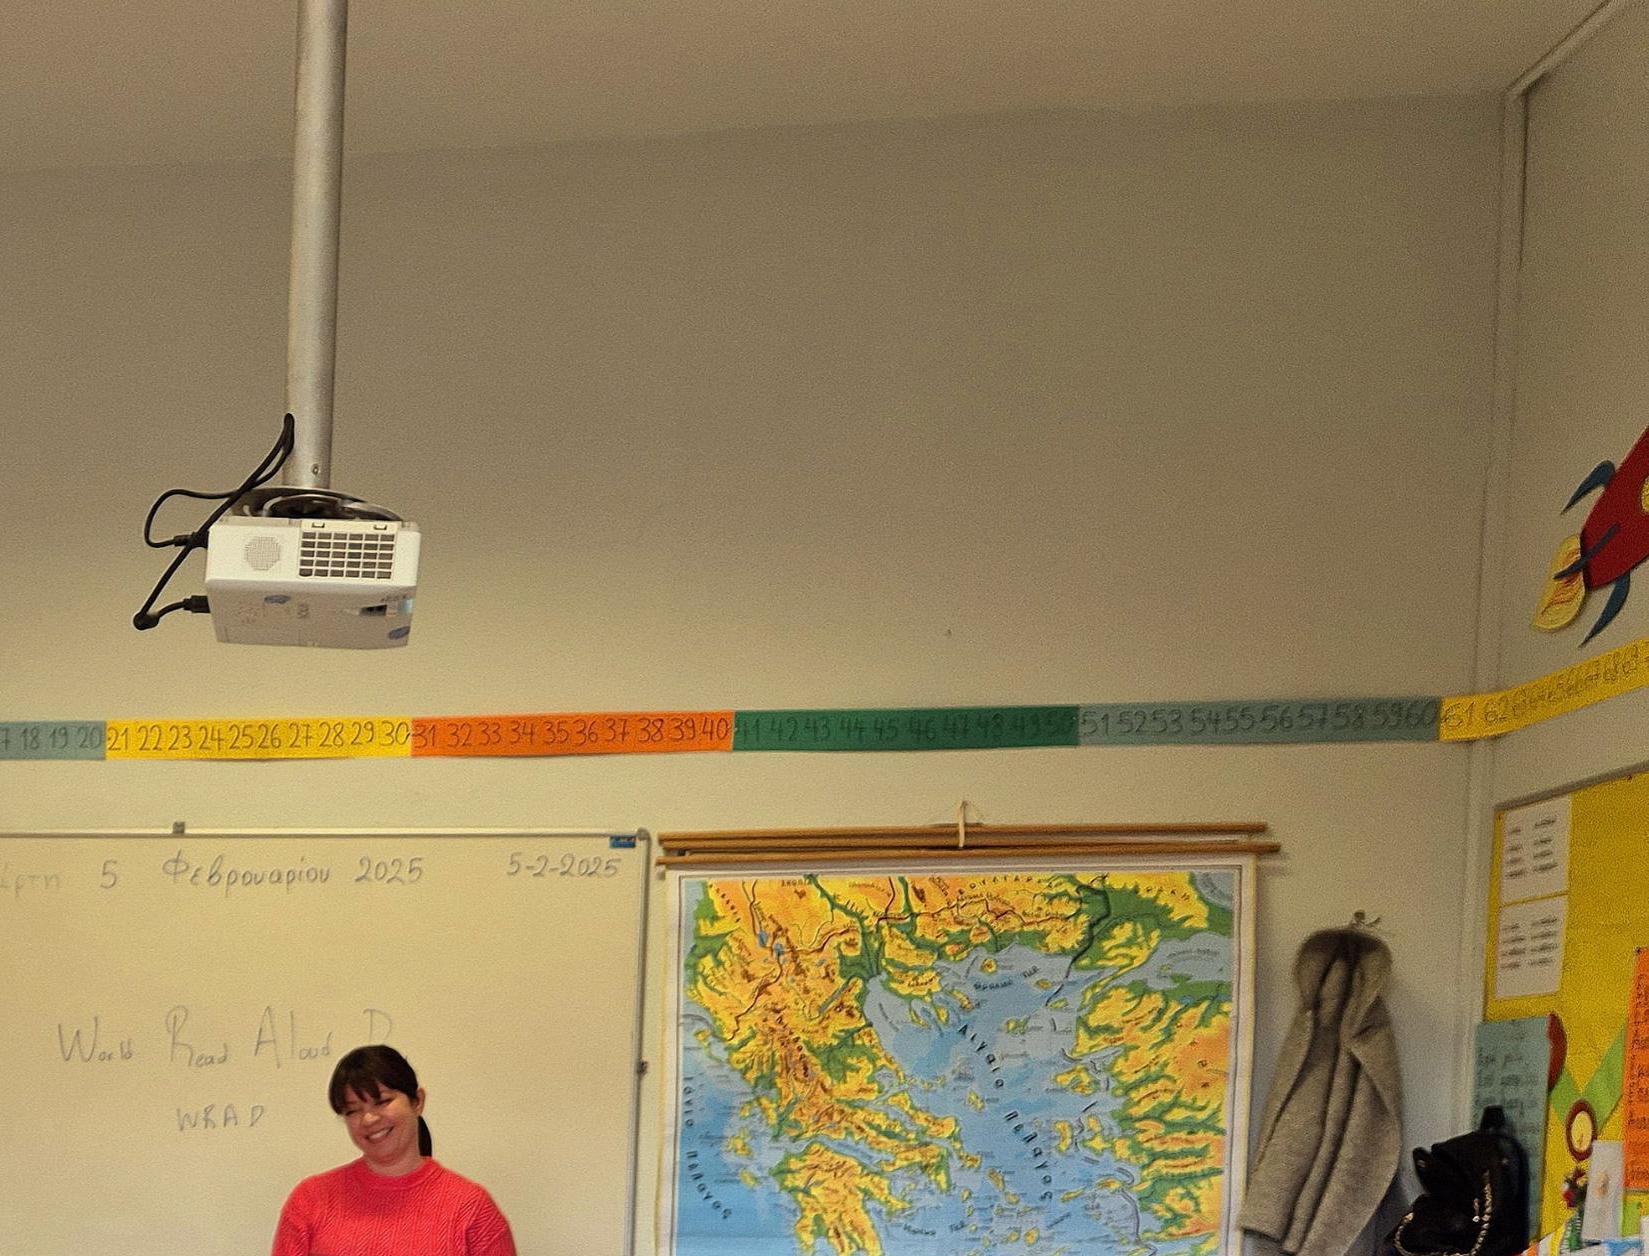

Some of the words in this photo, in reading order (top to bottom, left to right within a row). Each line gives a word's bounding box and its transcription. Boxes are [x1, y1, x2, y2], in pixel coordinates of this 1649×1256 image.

[21, 727, 40, 751] 18
[49, 726, 68, 750] 19
[78, 727, 102, 749] 20
[108, 727, 129, 752] 21
[137, 725, 163, 752] 22
[168, 725, 192, 751] 23
[199, 724, 225, 751] 24
[229, 724, 254, 750] 25
[258, 724, 282, 749] 26
[288, 723, 312, 749] 27
[318, 722, 345, 748] 28
[350, 721, 375, 747] 29
[379, 720, 410, 745] 30
[413, 724, 437, 749] 31
[449, 723, 473, 747] 32
[477, 723, 501, 746] 33
[509, 722, 535, 746] 34
[544, 722, 569, 745] 35
[573, 720, 599, 745] 36
[605, 717, 630, 743] 37
[637, 717, 664, 743] 38
[669, 716, 696, 741] 39
[699, 716, 730, 741] 40
[742, 717, 761, 744] 41
[770, 716, 798, 742] 42
[803, 716, 831, 742] 43
[839, 717, 868, 741] 44
[873, 716, 899, 741] 45
[909, 716, 936, 743] 46
[942, 715, 970, 741] 47
[976, 713, 1003, 742] 48
[1012, 714, 1040, 739] 49
[1080, 710, 1109, 736] 51
[1117, 710, 1147, 735] 52
[1151, 709, 1183, 735] 53
[1191, 708, 1221, 735] 54
[1225, 707, 1255, 734] 55
[1261, 705, 1293, 733] 56
[1297, 703, 1328, 730] 57
[1333, 703, 1365, 731] 58
[1373, 702, 1403, 730] 59
[1406, 700, 1439, 728] 60
[100, 860, 120, 889] 5
[161, 849, 330, 898] Φεβρουαρίου
[353, 855, 423, 885] 2025
[508, 851, 622, 879] 5-2-2025
[165, 1004, 229, 1069] Read
[253, 1004, 332, 1069] Aloud
[176, 1103, 265, 1132] WRAD
